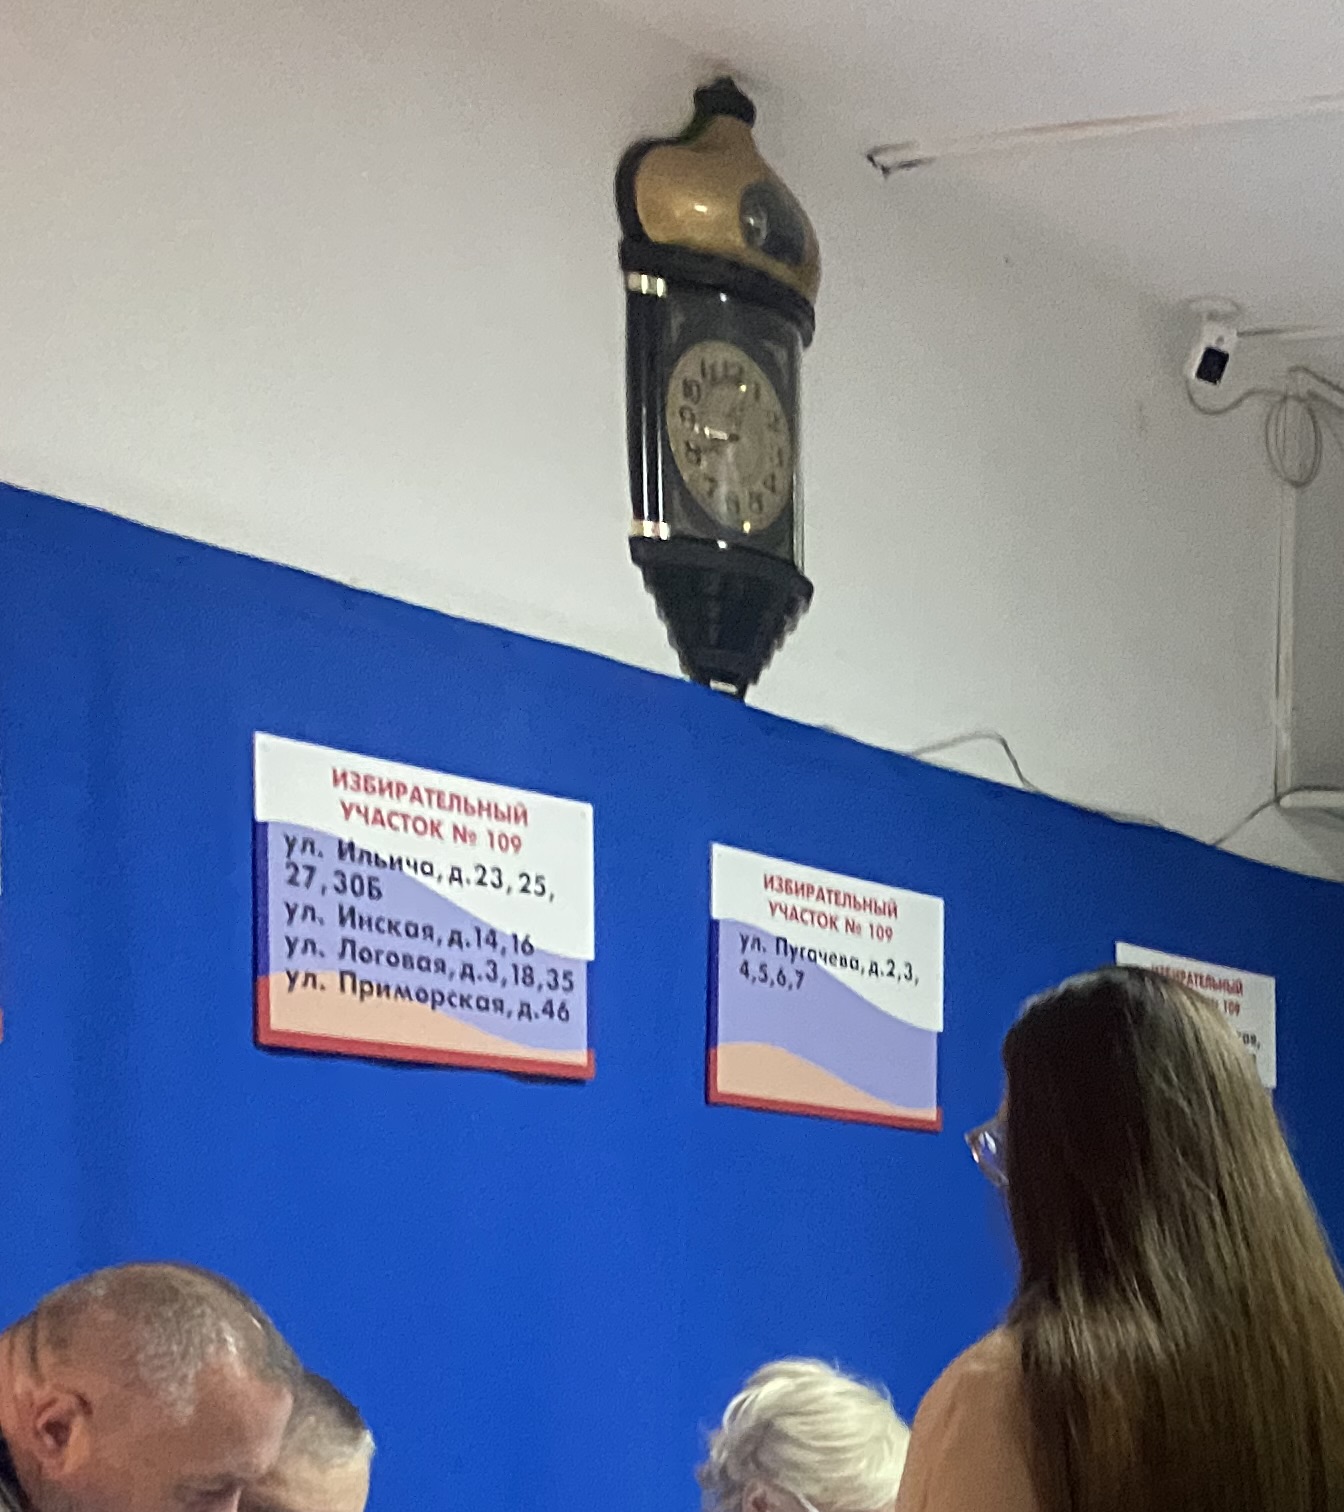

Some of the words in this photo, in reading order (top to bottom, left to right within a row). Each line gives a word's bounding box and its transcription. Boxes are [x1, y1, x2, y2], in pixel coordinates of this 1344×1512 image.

[331, 767, 529, 827] ИЗБИРАТЕЛЬНЫЙ
[340, 800, 443, 839] УЧАСТОК
[488, 832, 523, 855] 109
[284, 832, 324, 859] ул.
[763, 873, 898, 919] ИЗБИРАТЕЛЬНЫЙ
[284, 901, 325, 926] ул.
[768, 900, 838, 932] УЧАСТОК
[869, 923, 893, 942] 109
[285, 935, 326, 960] ул.
[739, 933, 766, 954] ул.
[285, 968, 327, 993] ул.
